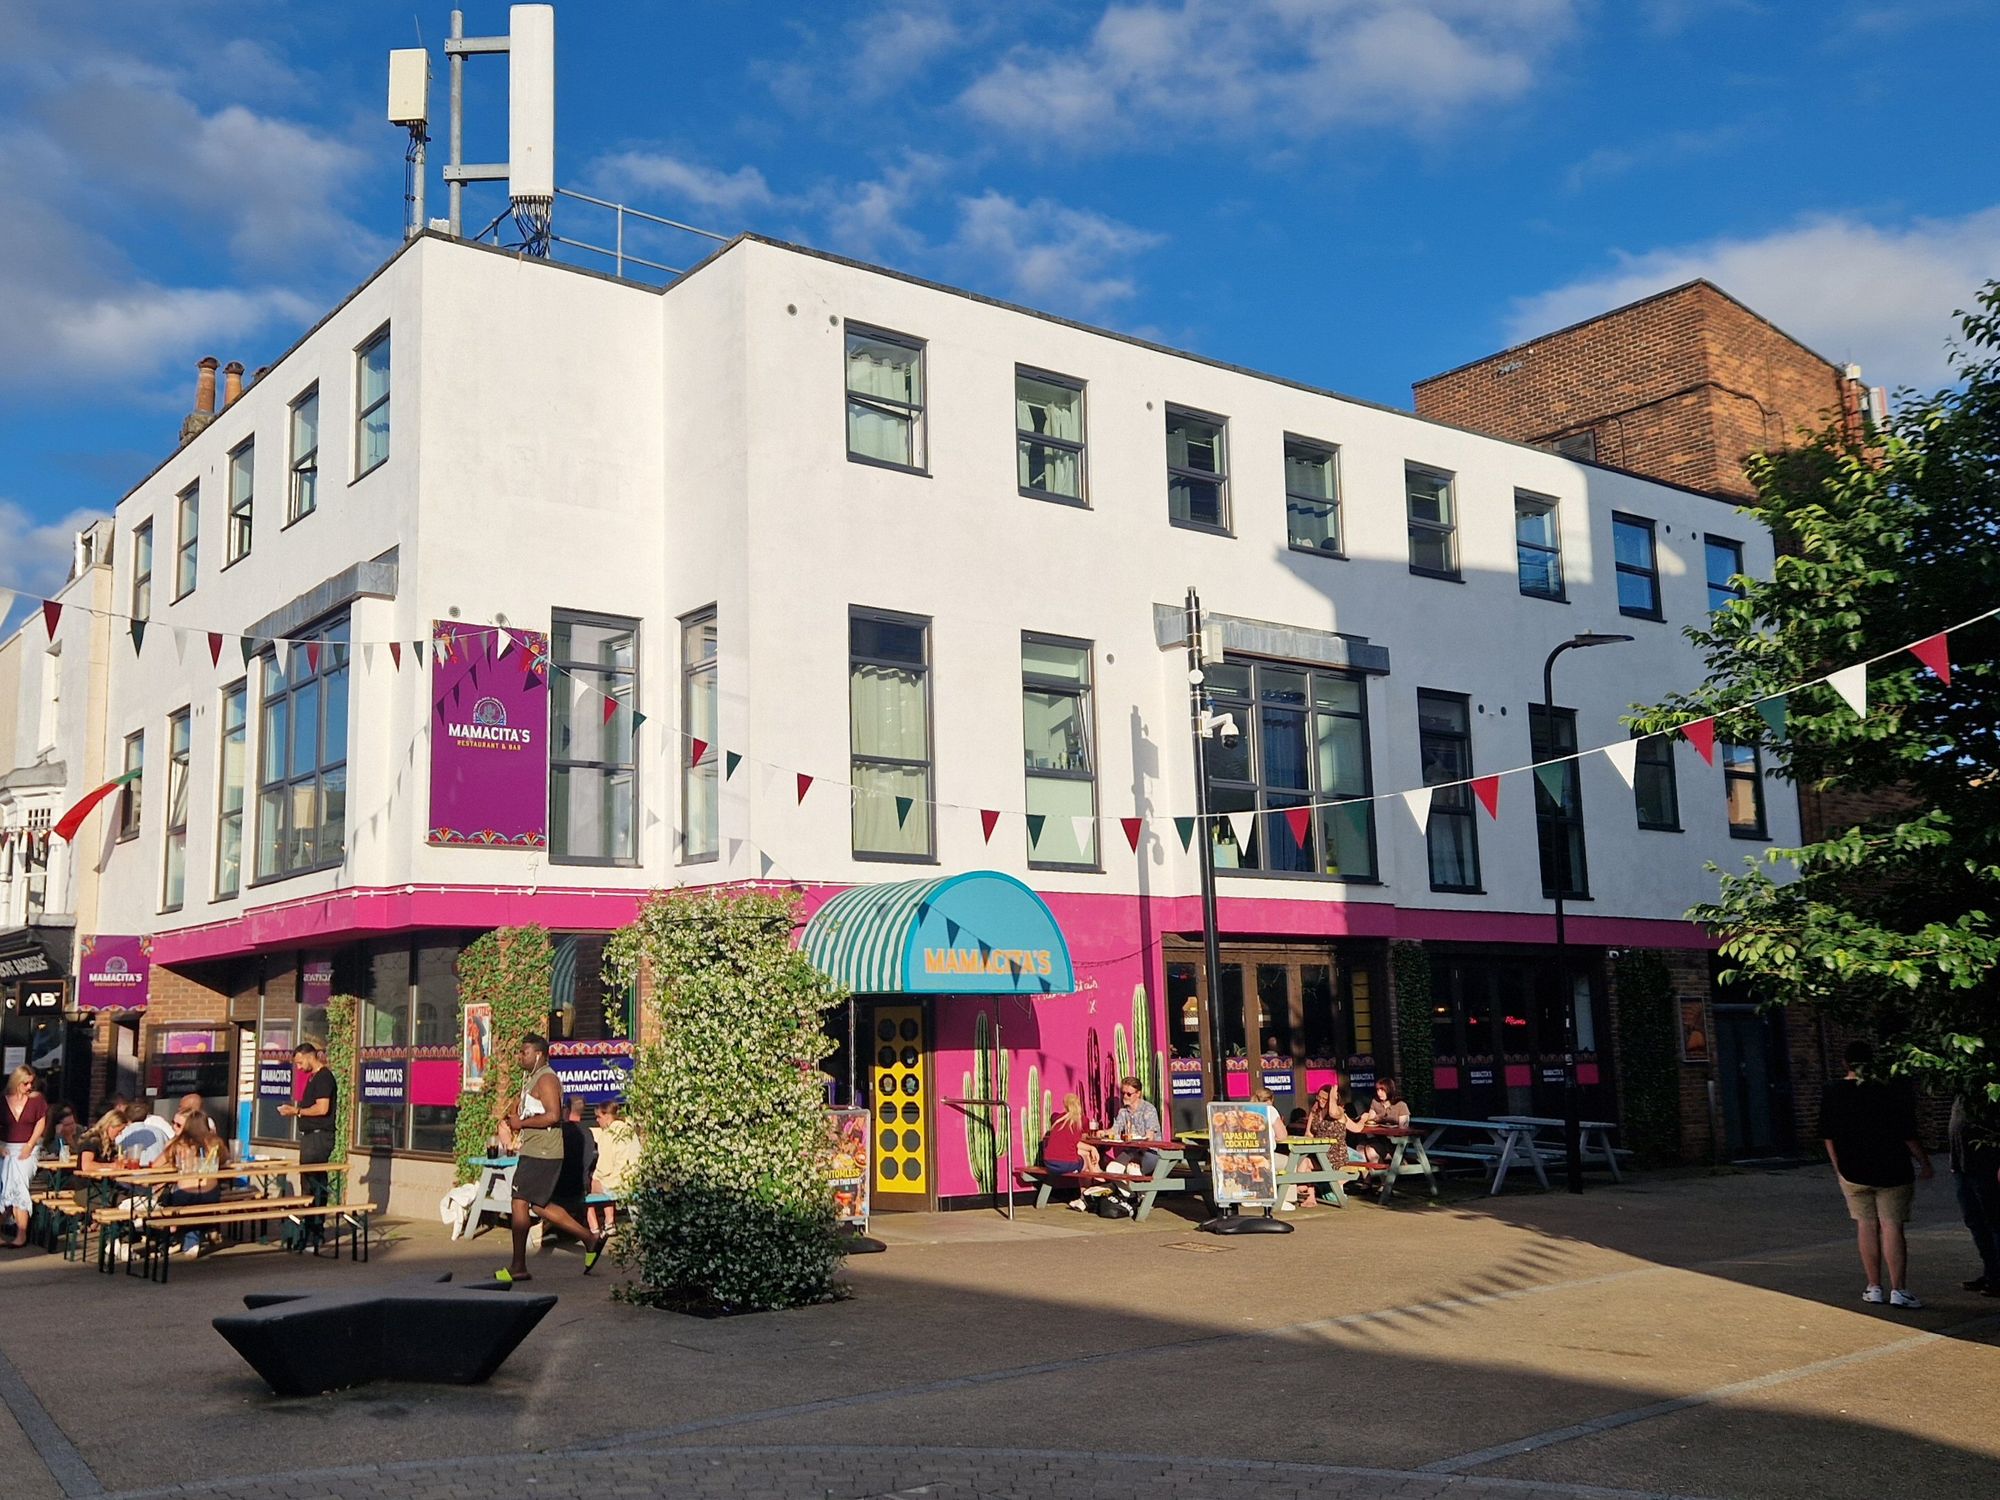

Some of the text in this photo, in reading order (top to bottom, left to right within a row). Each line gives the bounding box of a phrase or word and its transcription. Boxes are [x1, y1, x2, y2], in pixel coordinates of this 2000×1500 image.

[448, 723, 531, 743] MAMACITA'S
[457, 739, 499, 749] RESTAURANT
[924, 948, 1052, 975] MAMACITA'S
[88, 973, 143, 983] MAMACITA'S
[365, 1068, 403, 1083] MAMACITA'S
[557, 1069, 625, 1083] MAMACITA'S
[365, 1087, 389, 1097] RESTAURANT
[563, 1083, 603, 1093] ESTAURANT
[1222, 1132, 1257, 1140] TAPAS AND
[1225, 1140, 1260, 1148] COCKTAILS
[826, 1168, 861, 1179] TTOMLESS
